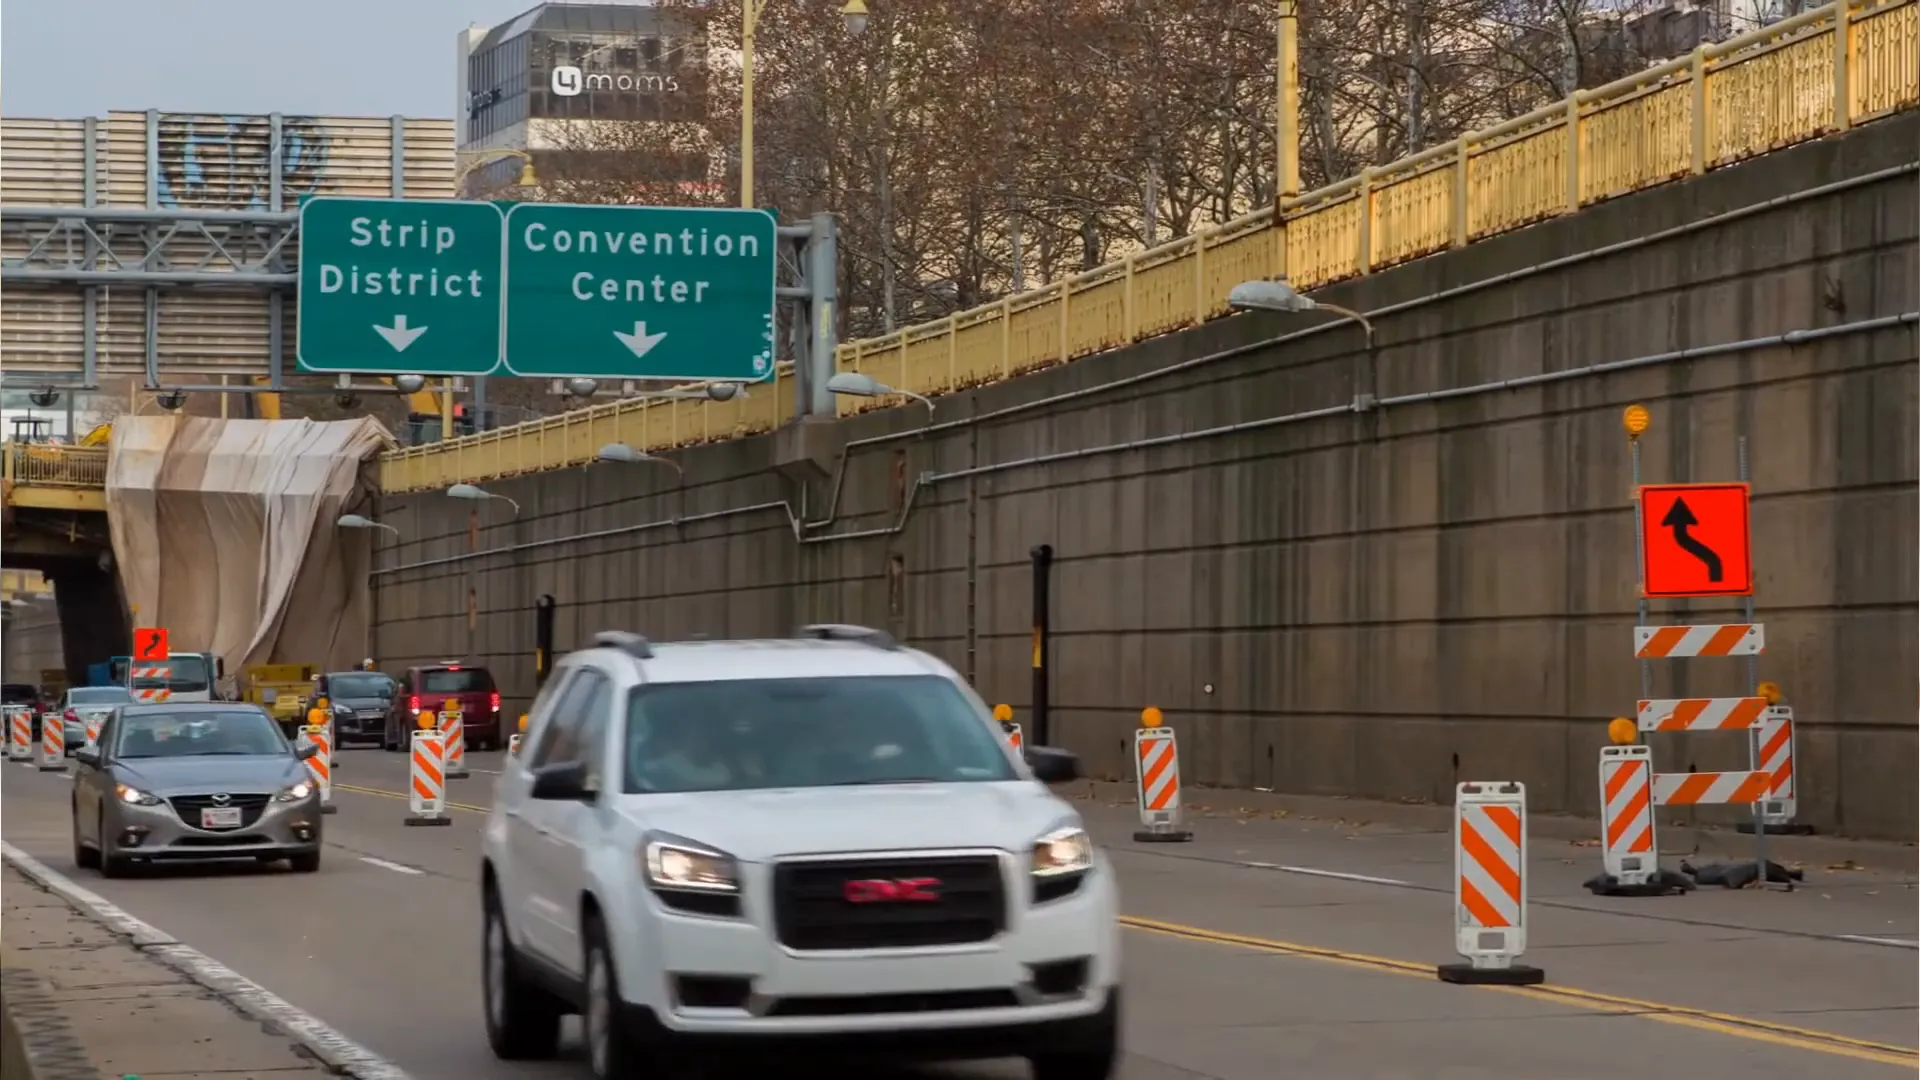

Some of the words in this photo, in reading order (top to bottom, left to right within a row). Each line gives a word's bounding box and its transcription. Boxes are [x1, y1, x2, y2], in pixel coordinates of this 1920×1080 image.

[350, 216, 456, 254] Strip
[523, 223, 760, 257] Convention
[319, 265, 483, 299] District
[572, 272, 710, 303] Center
